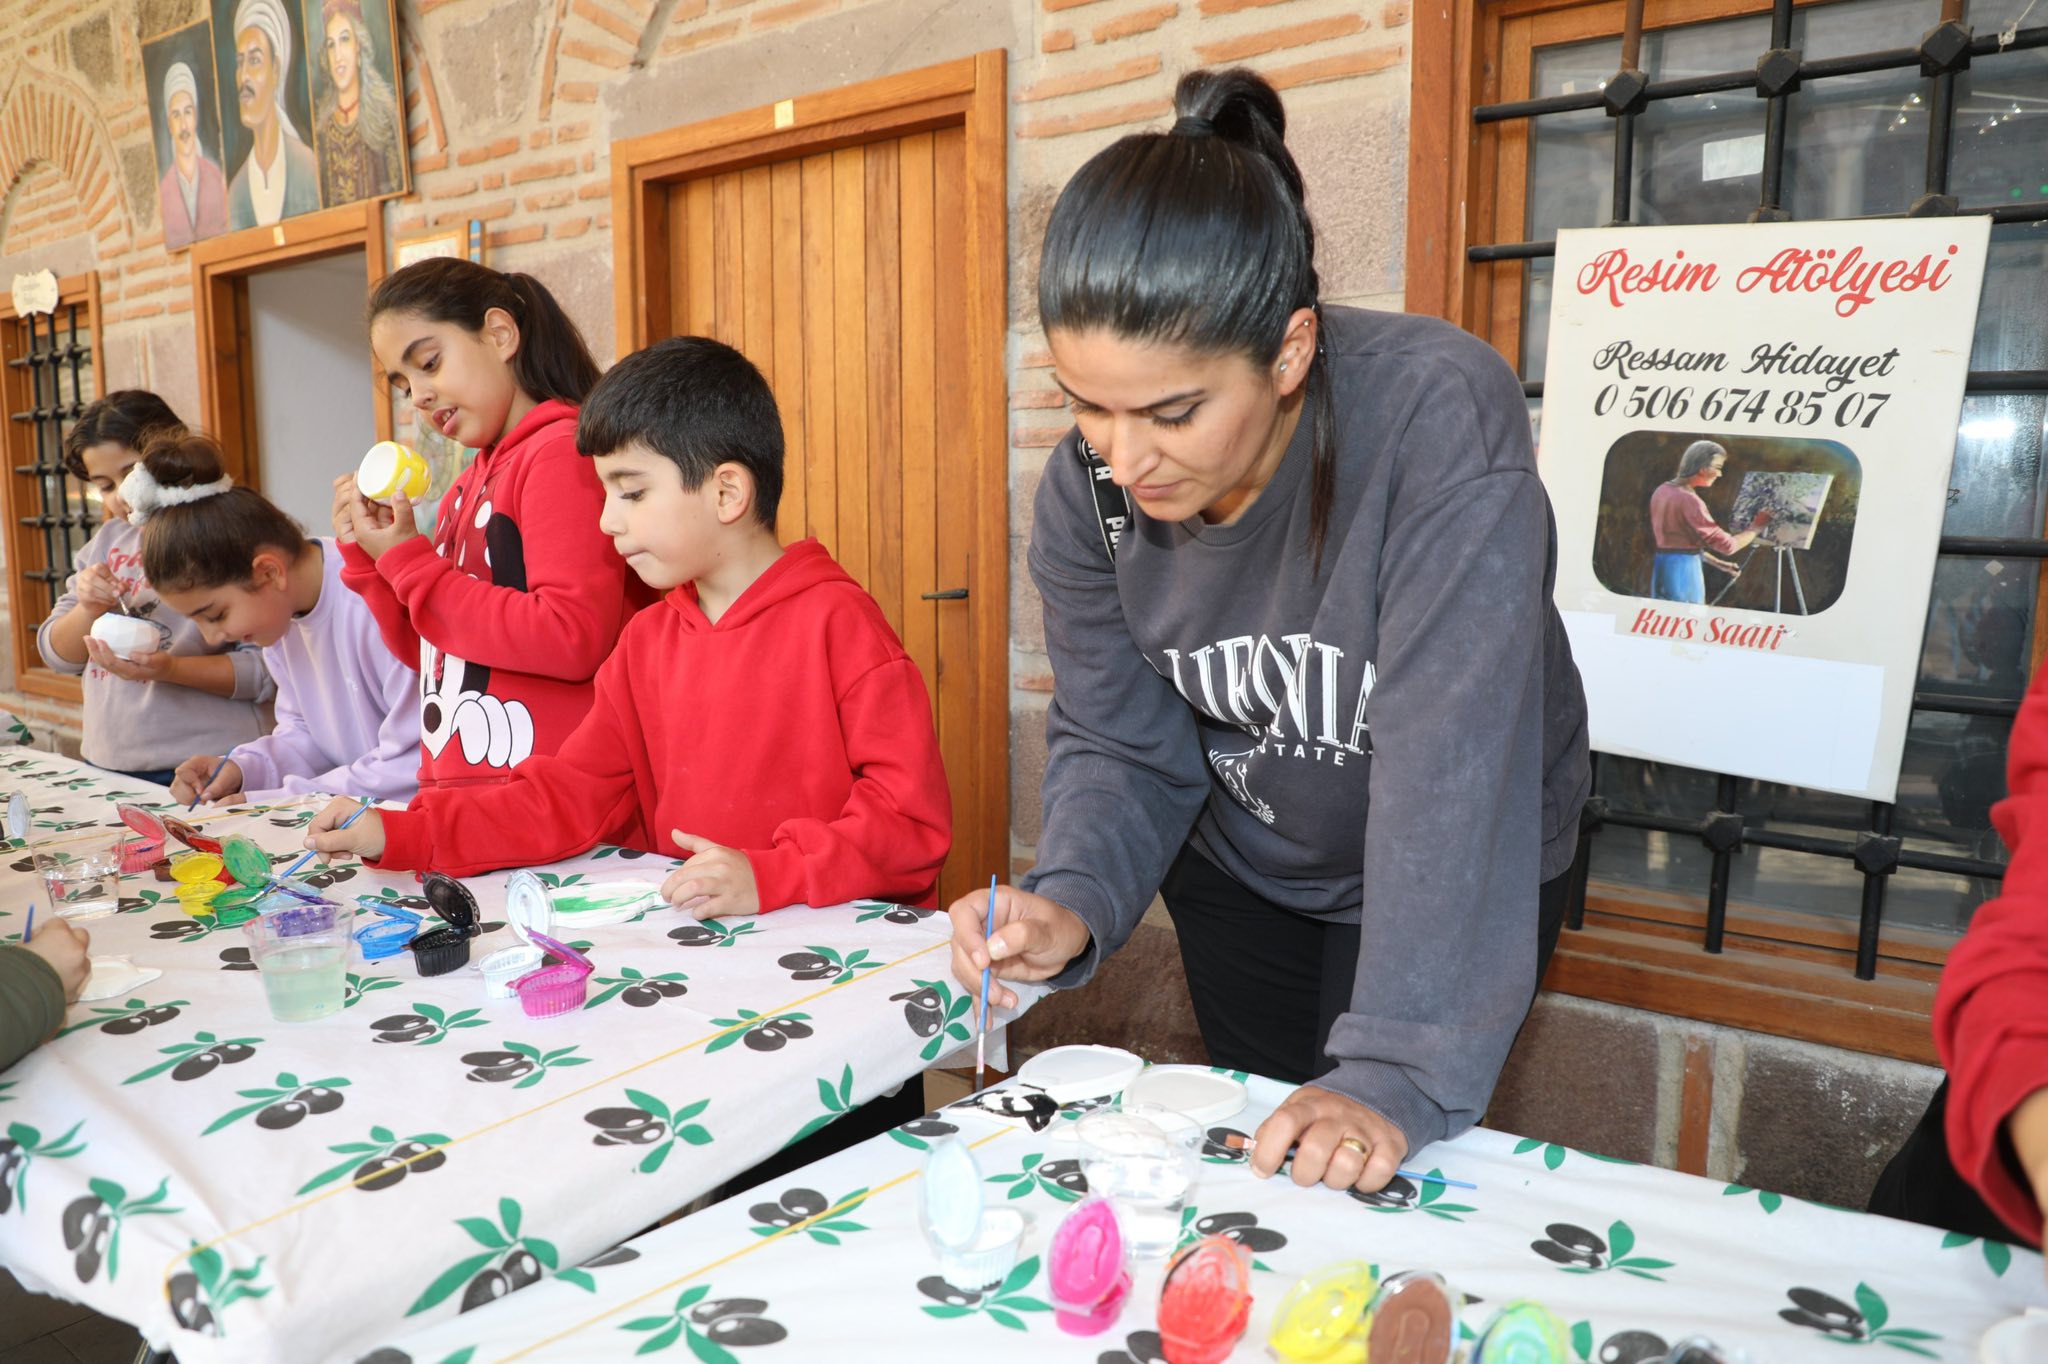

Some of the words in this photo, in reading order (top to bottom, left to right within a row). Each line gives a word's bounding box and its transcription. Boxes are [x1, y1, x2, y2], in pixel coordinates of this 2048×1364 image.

[1577, 248, 1720, 308] Resim
[1735, 244, 1959, 318] Atölyesi
[1592, 339, 1729, 380] Ressam
[1740, 341, 1901, 393] Hidayet
[1593, 384, 1619, 418] 0
[1623, 385, 1690, 421] 506
[1699, 387, 1766, 424] 674
[1773, 390, 1824, 427] 85
[1834, 392, 1892, 430] 07
[1630, 607, 1699, 641] Kurs
[1703, 616, 1788, 651] Saati
